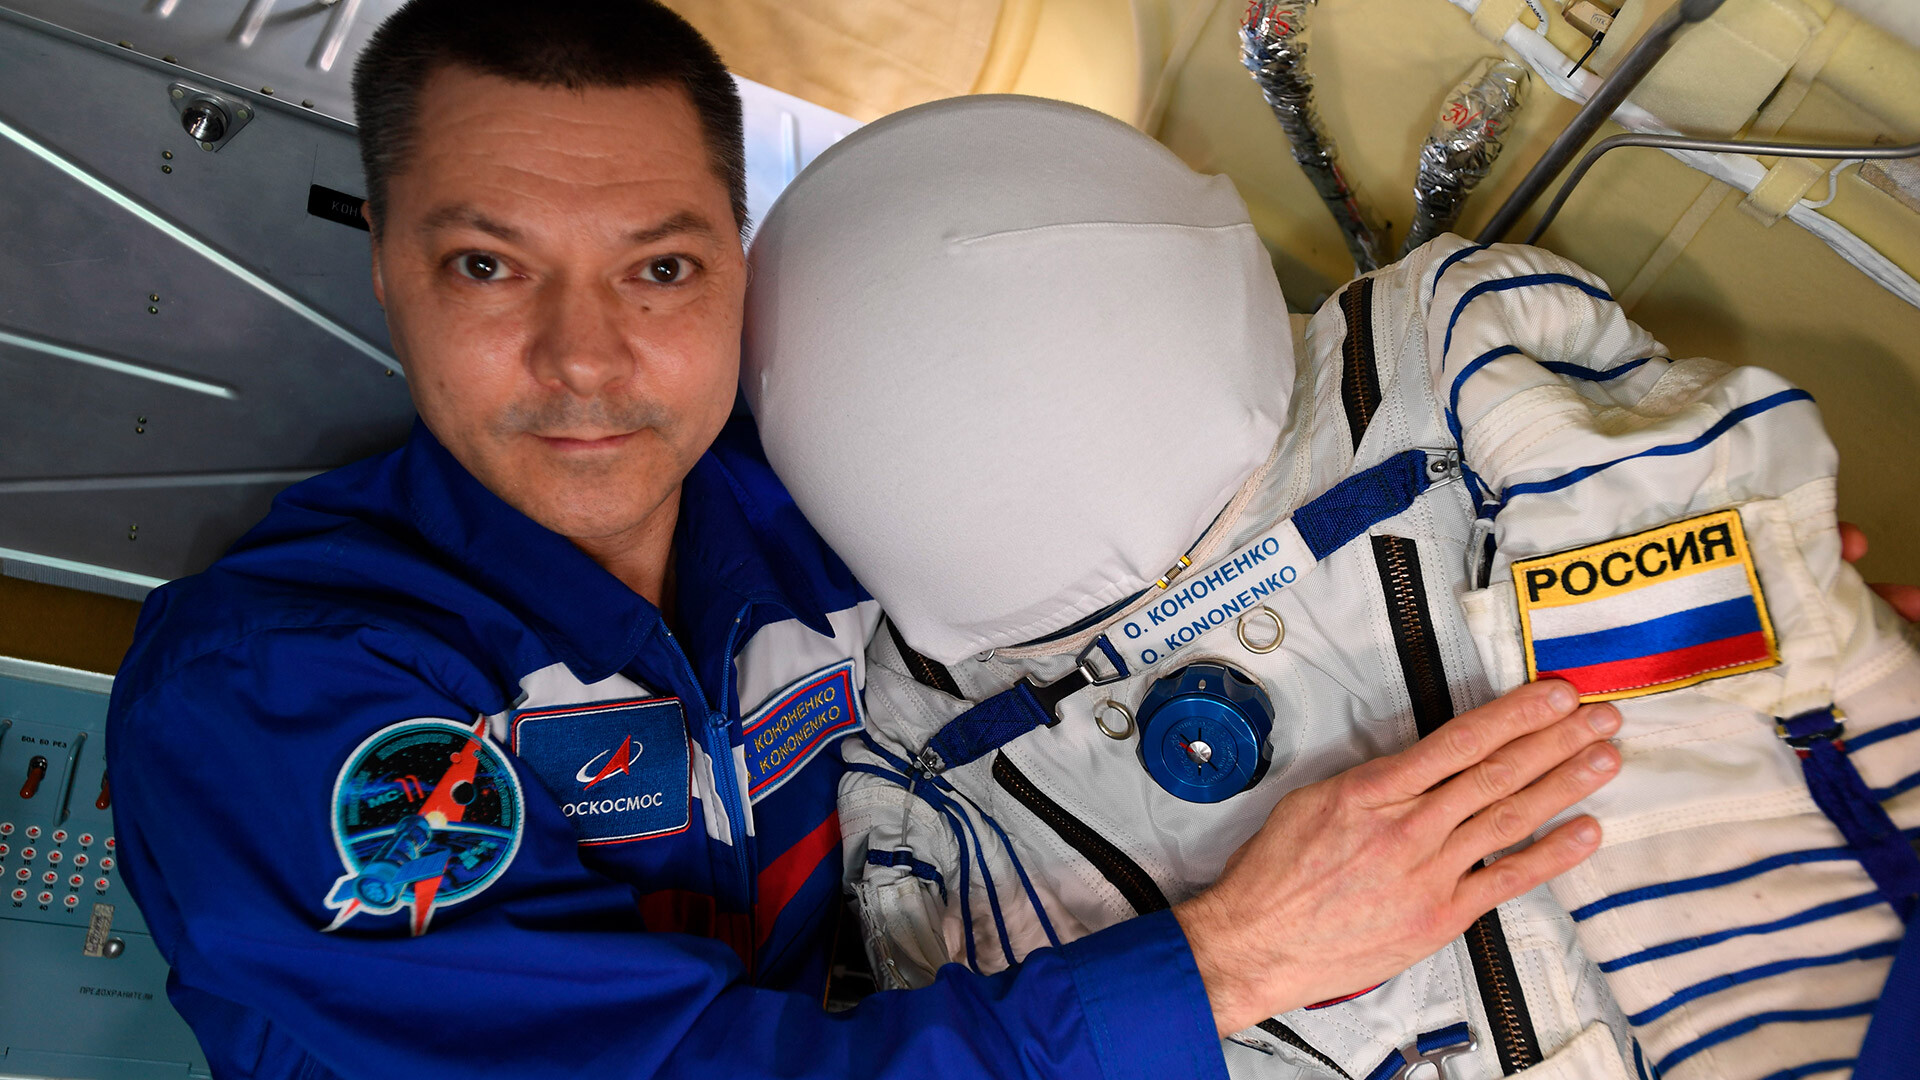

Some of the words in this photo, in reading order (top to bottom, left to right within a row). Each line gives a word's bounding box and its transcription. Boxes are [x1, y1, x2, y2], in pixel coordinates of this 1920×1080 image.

[331, 200, 362, 219] КОН
[1123, 622, 1148, 639] О.
[1147, 537, 1280, 627] КОНОНЕНКО
[1526, 523, 1736, 602] РОССИЯ
[1141, 649, 1164, 664] O.
[1164, 565, 1297, 651] KONONENKO
[753, 686, 836, 753] КОНОНЕНКО
[759, 705, 841, 774] KONONENKO
[559, 792, 663, 818] ОСКОСМОС
